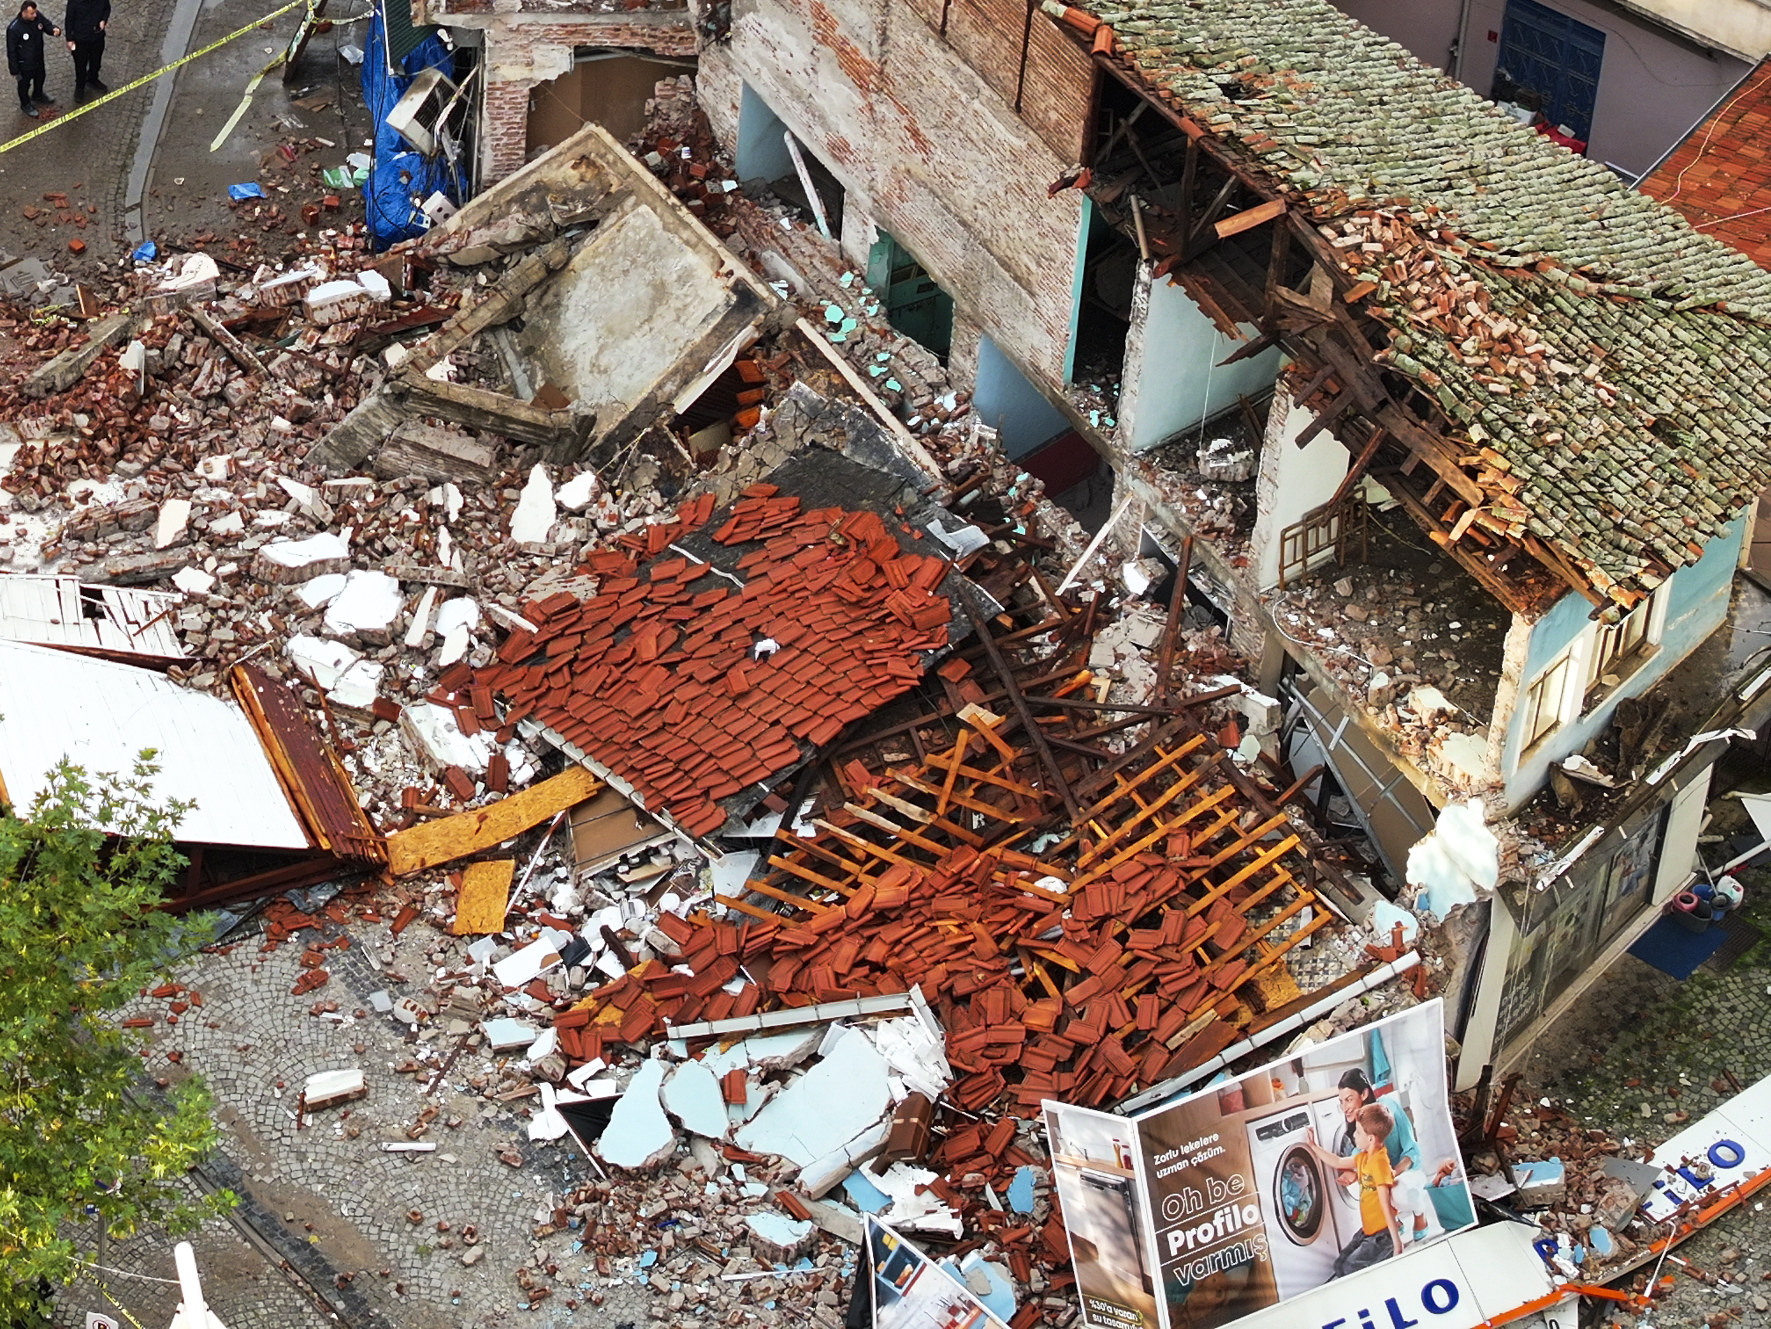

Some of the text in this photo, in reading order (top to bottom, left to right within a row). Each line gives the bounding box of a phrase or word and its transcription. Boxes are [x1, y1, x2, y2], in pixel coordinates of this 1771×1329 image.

[1154, 1133, 1220, 1166] Zorlu lekelere
[1156, 1146, 1226, 1179] uzman çözüm.
[1162, 1174, 1245, 1221] Oh be
[1167, 1204, 1259, 1256] Profilo
[1173, 1233, 1269, 1286] varmış
[1113, 1307, 1138, 1322] varan
